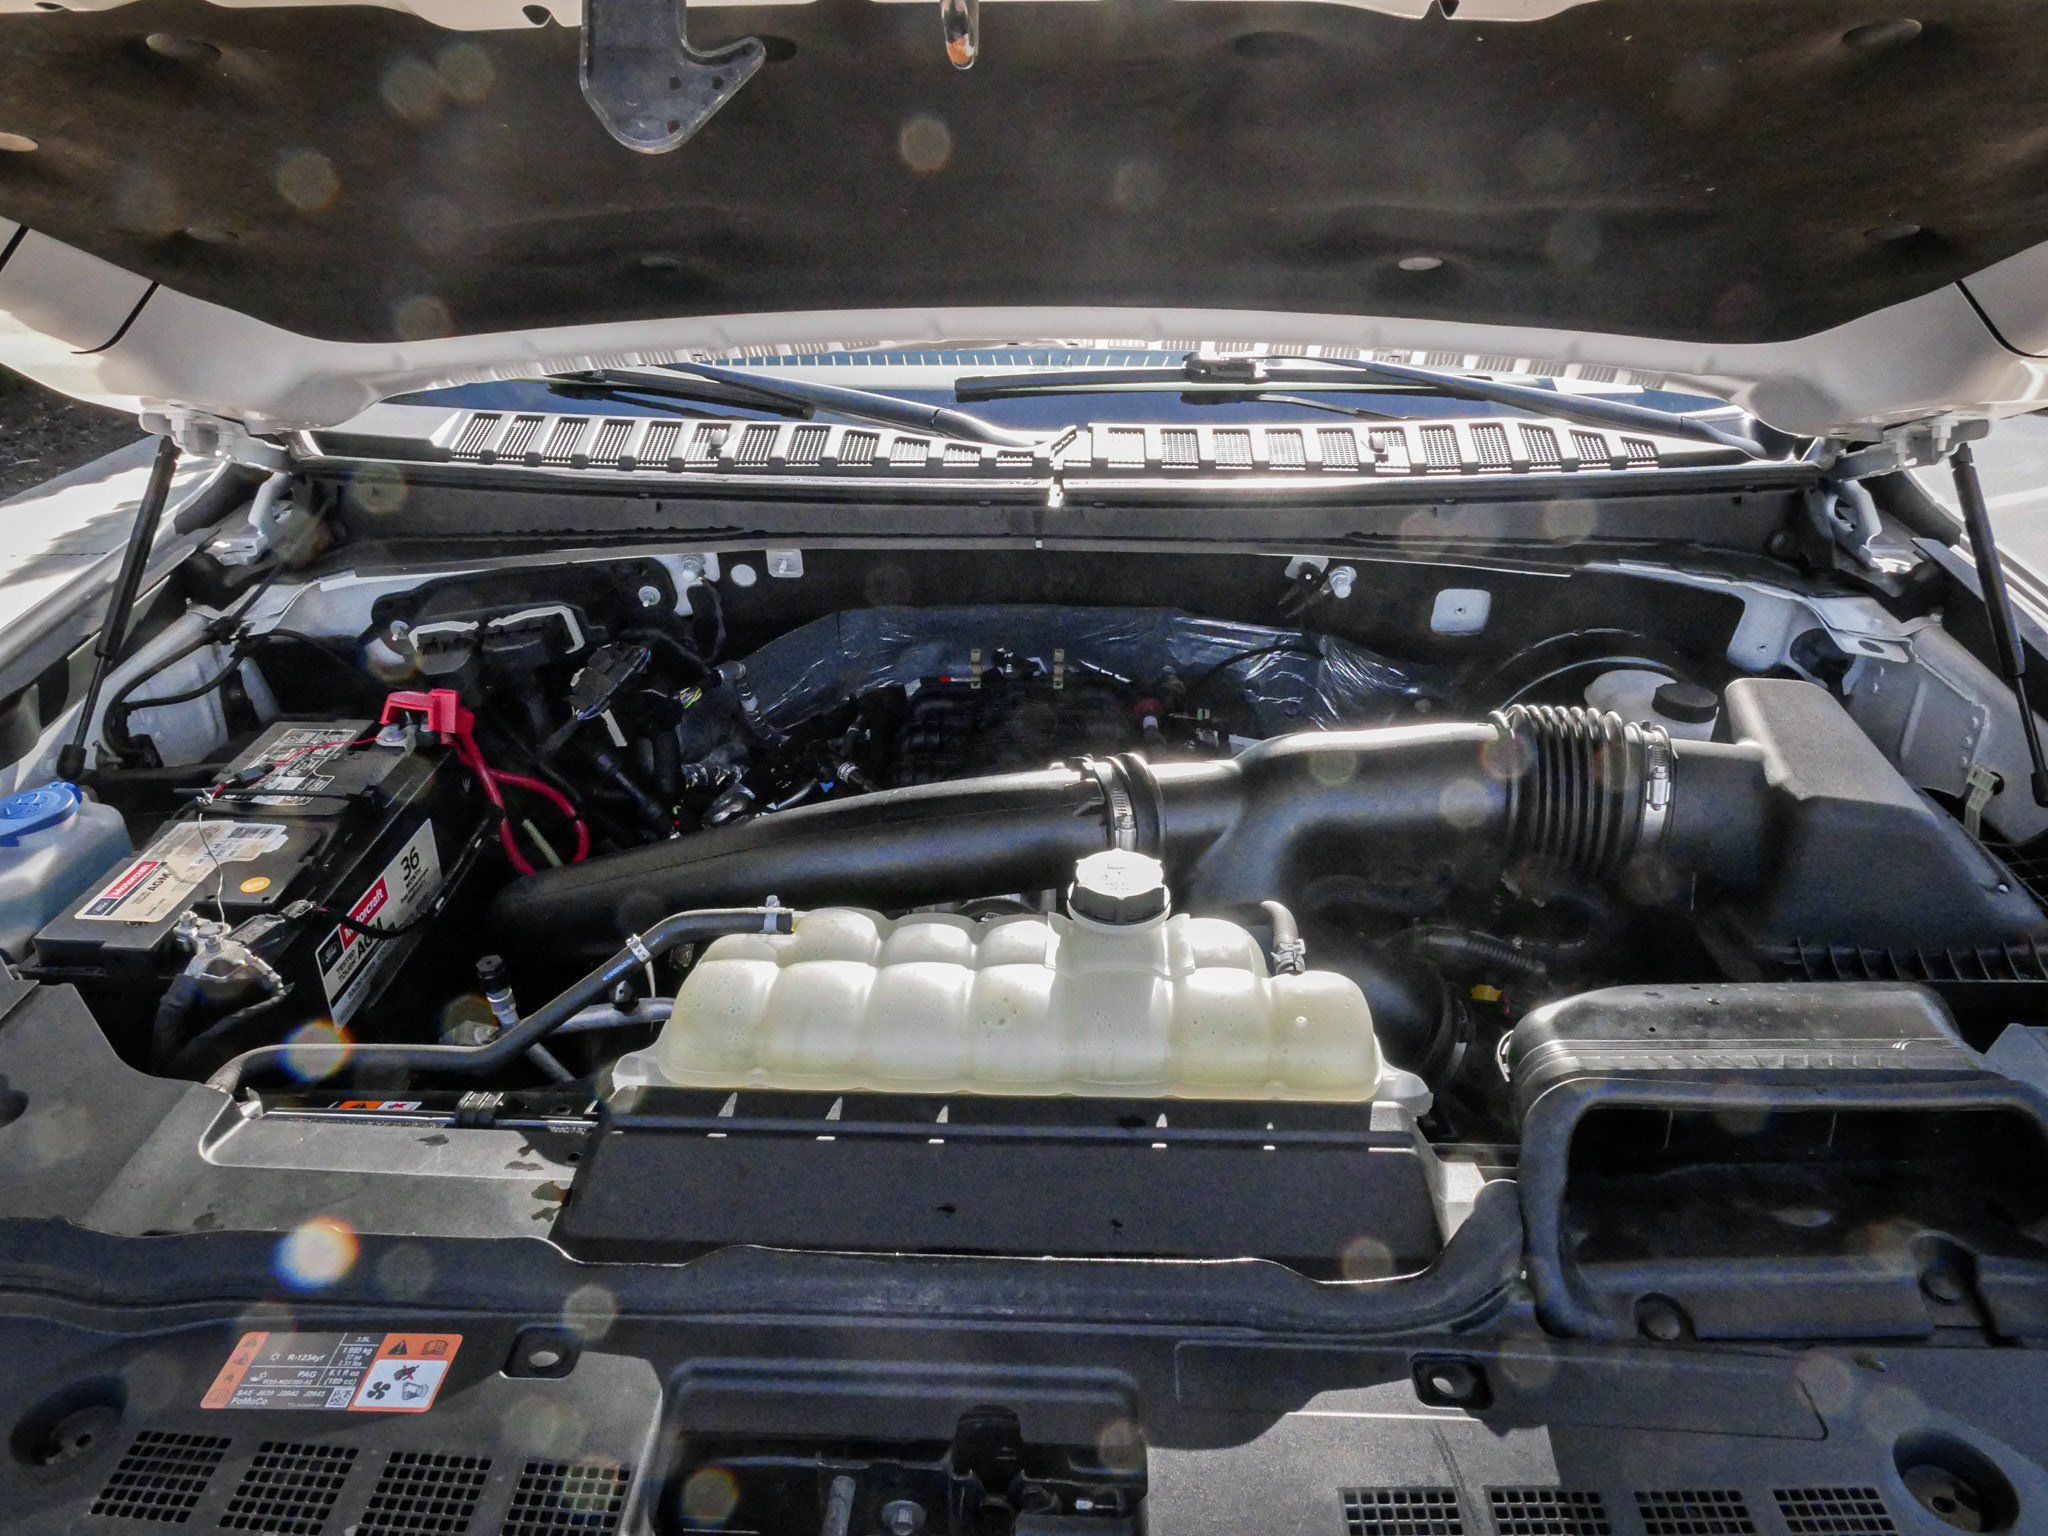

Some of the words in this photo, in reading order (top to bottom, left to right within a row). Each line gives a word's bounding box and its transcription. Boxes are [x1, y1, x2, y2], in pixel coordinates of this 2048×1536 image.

[400, 845, 420, 882] 36
[149, 871, 173, 891] AGM
[344, 887, 384, 941] Mtorcraft
[287, 1353, 326, 1363] R-1234yf
[297, 1370, 317, 1378] PAG
[230, 1397, 269, 1406] FoMoCo
